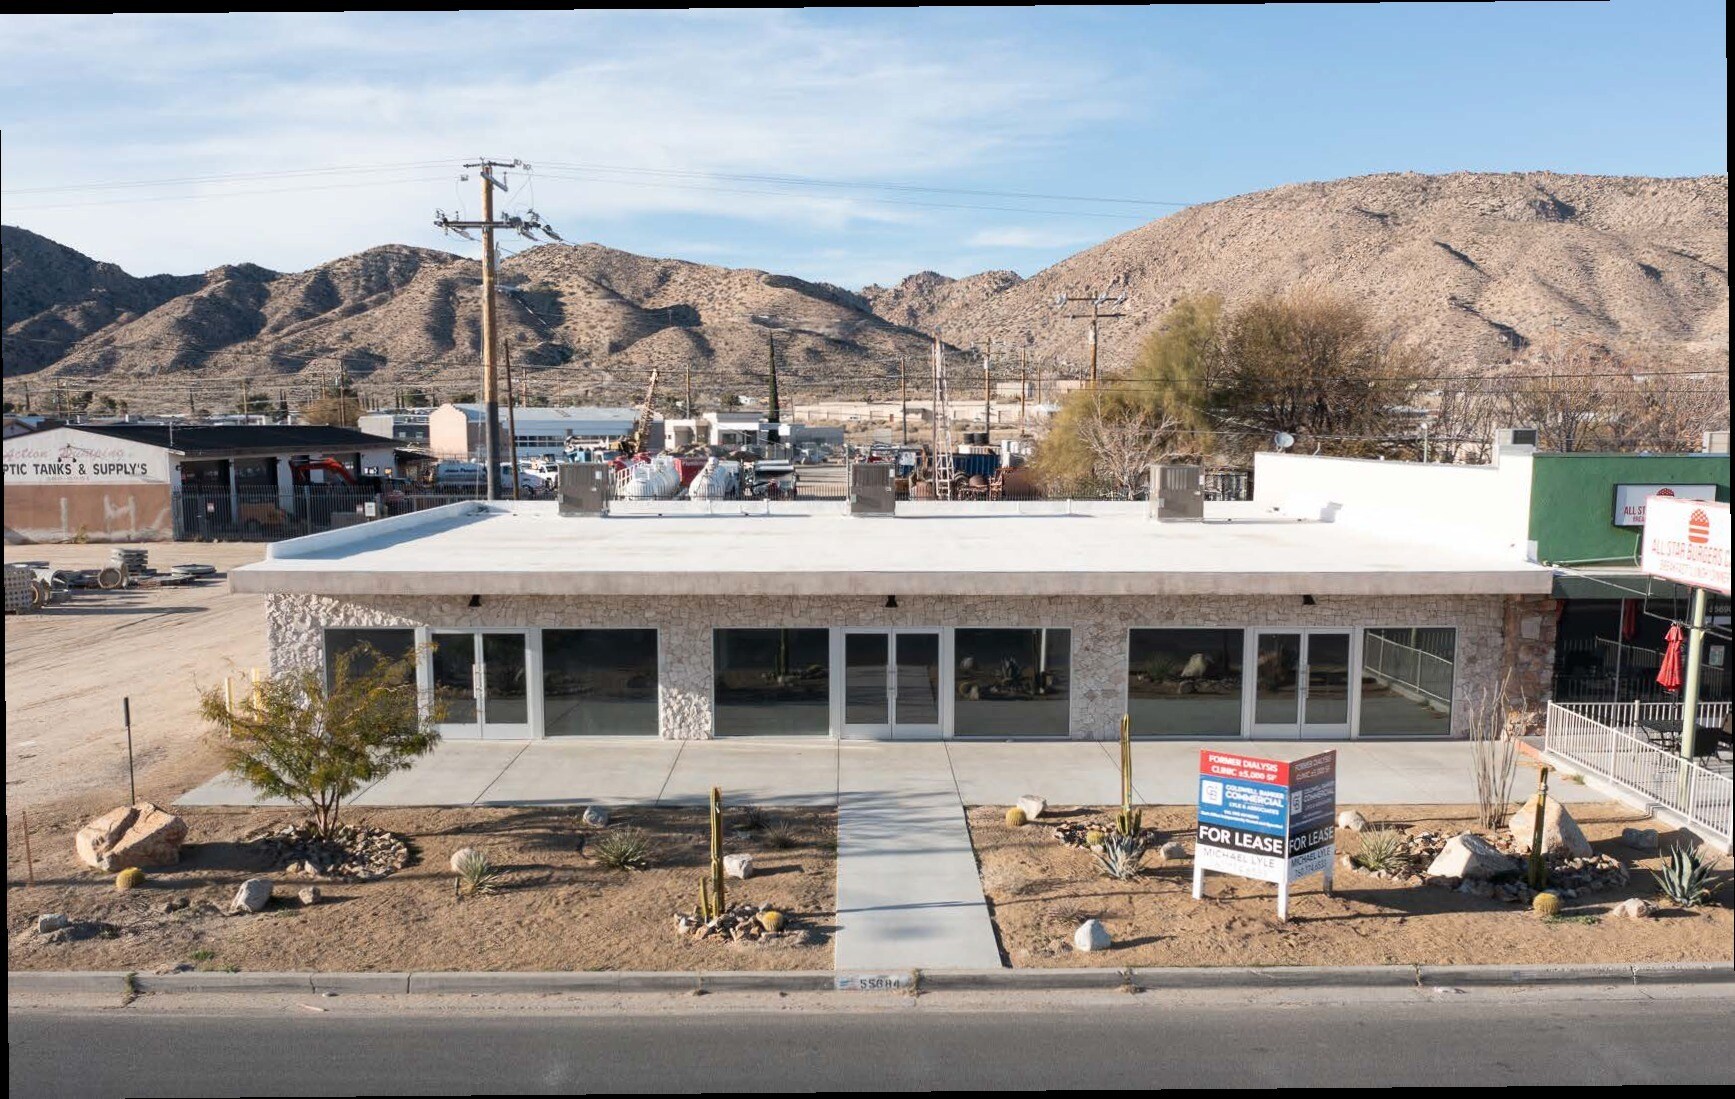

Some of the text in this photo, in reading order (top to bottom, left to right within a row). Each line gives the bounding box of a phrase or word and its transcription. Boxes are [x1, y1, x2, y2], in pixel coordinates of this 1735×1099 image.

[33, 463, 72, 475] TANKS
[78, 463, 86, 475] &
[93, 462, 148, 475] SUPPLY'S
[1624, 505, 1636, 515] ALL
[1652, 538, 1665, 556] ALL
[1667, 541, 1686, 559] STAR
[1687, 543, 1723, 567] BURGERS
[1209, 754, 1278, 773] FORMER DIALYSIS
[1211, 765, 1237, 777] CLINIC
[1267, 773, 1277, 782] SF
[1225, 791, 1285, 808] COMMERCIAL
[1199, 825, 1283, 854] FOR LEASE
[1289, 826, 1334, 853] FOR LEASE
[1203, 848, 1276, 869] MICHAEL LYLE
[1291, 846, 1331, 868] MICHAEL LYLE
